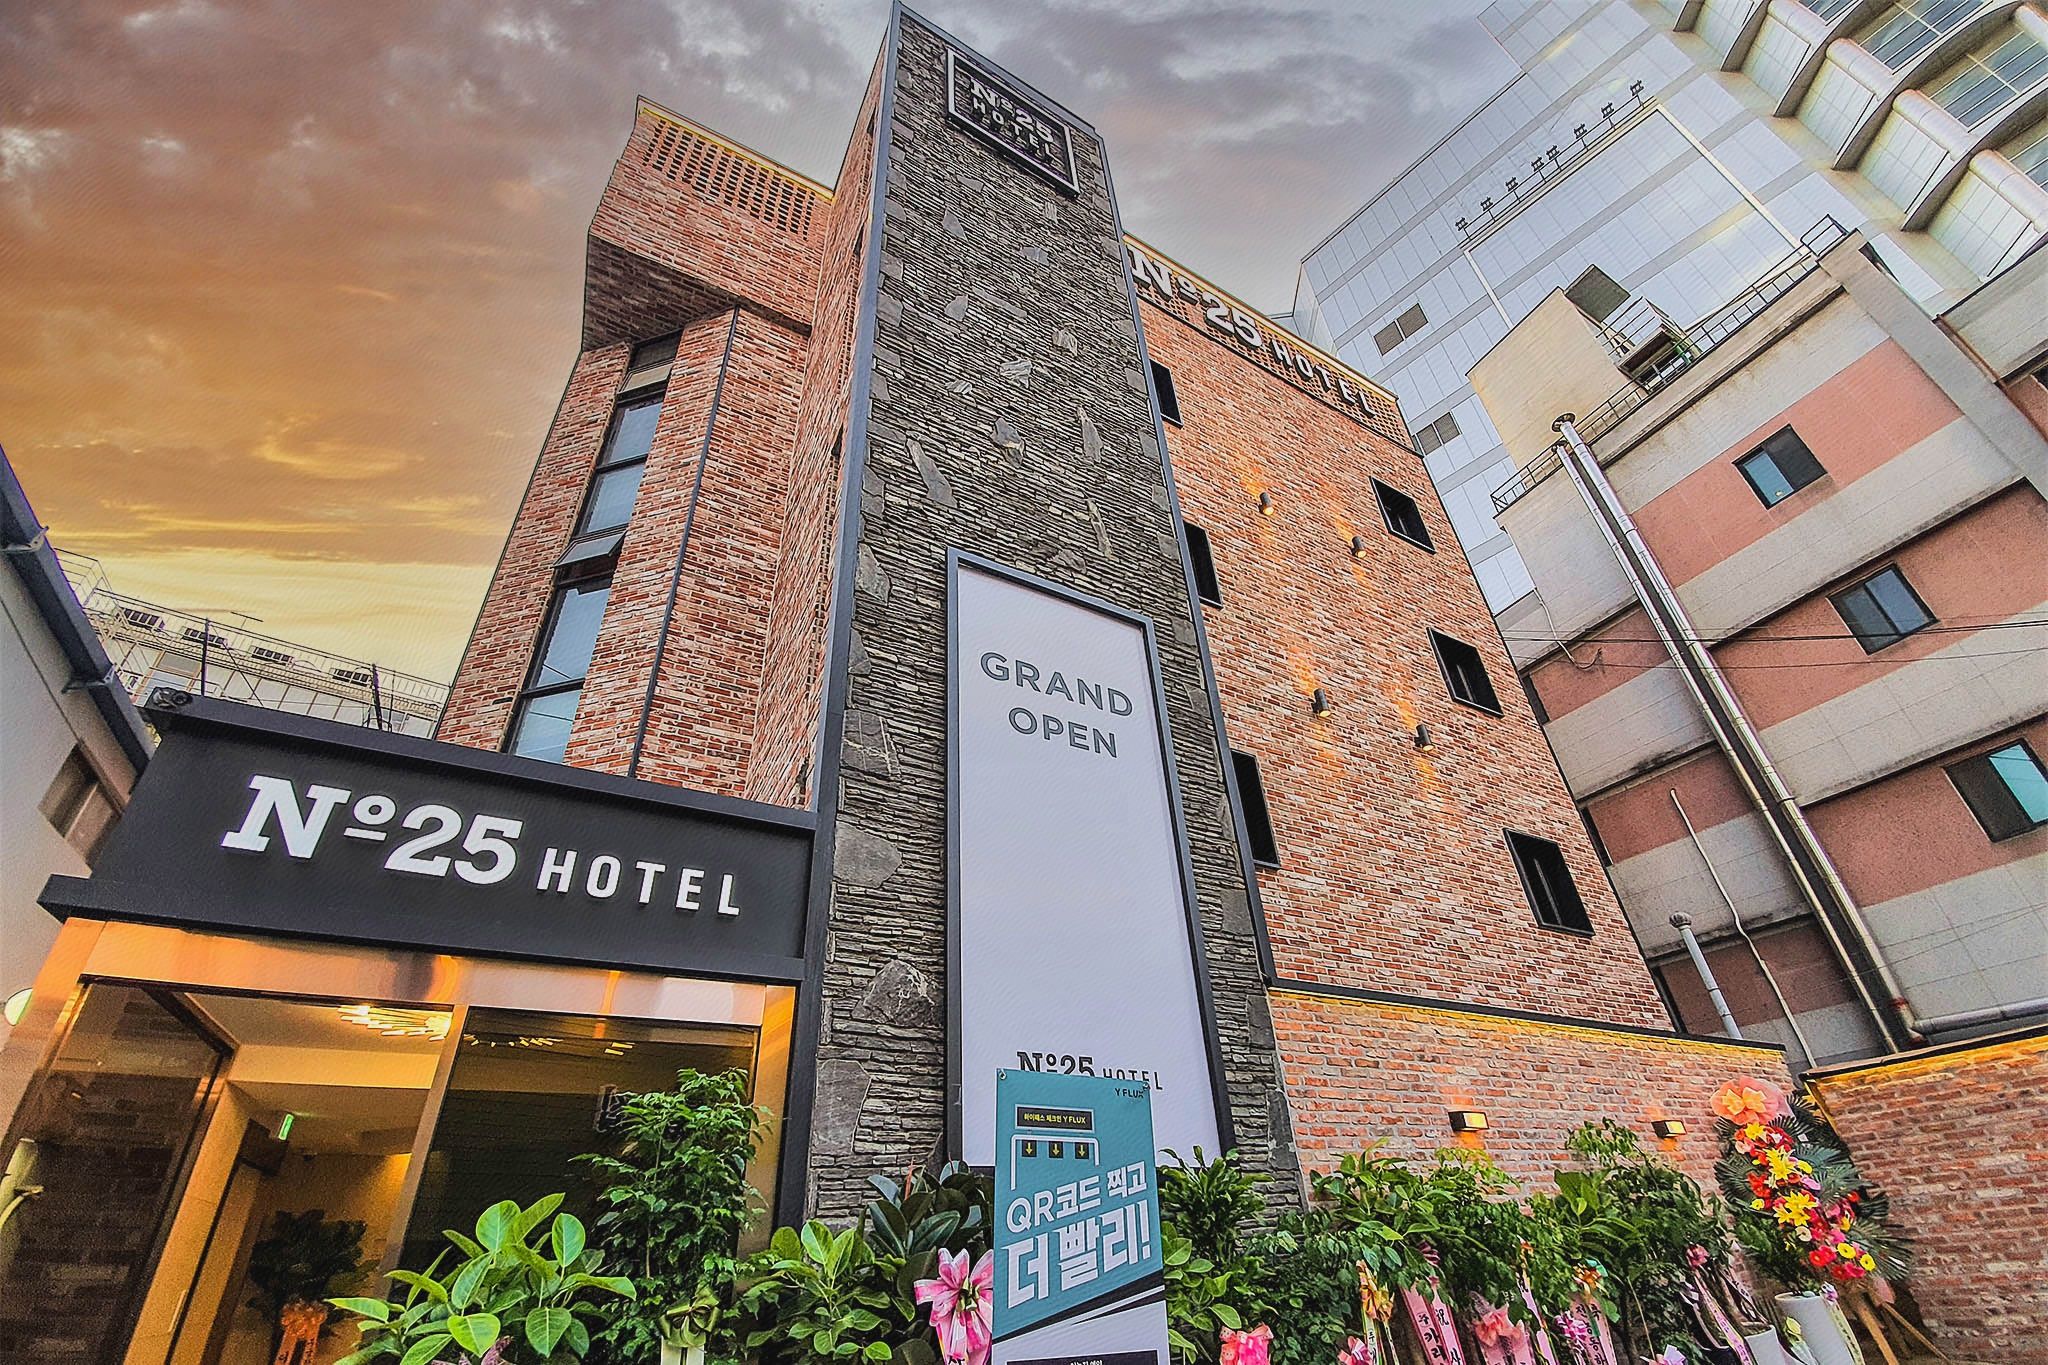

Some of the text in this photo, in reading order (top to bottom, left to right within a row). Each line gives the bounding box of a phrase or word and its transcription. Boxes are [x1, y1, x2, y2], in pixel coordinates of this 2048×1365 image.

[973, 97, 1051, 155] HOTEL
[1269, 339, 1378, 418] HOTEL
[980, 652, 1133, 717] GRAND
[1008, 707, 1118, 758] OPEN
[536, 847, 741, 917] HOTEL
[1068, 1116, 1086, 1124] FLUX
[1115, 1088, 1144, 1099] Y FLUX
[1007, 1161, 1147, 1233] QR코드 찍고
[1001, 1199, 1151, 1309] 더 빨리!
